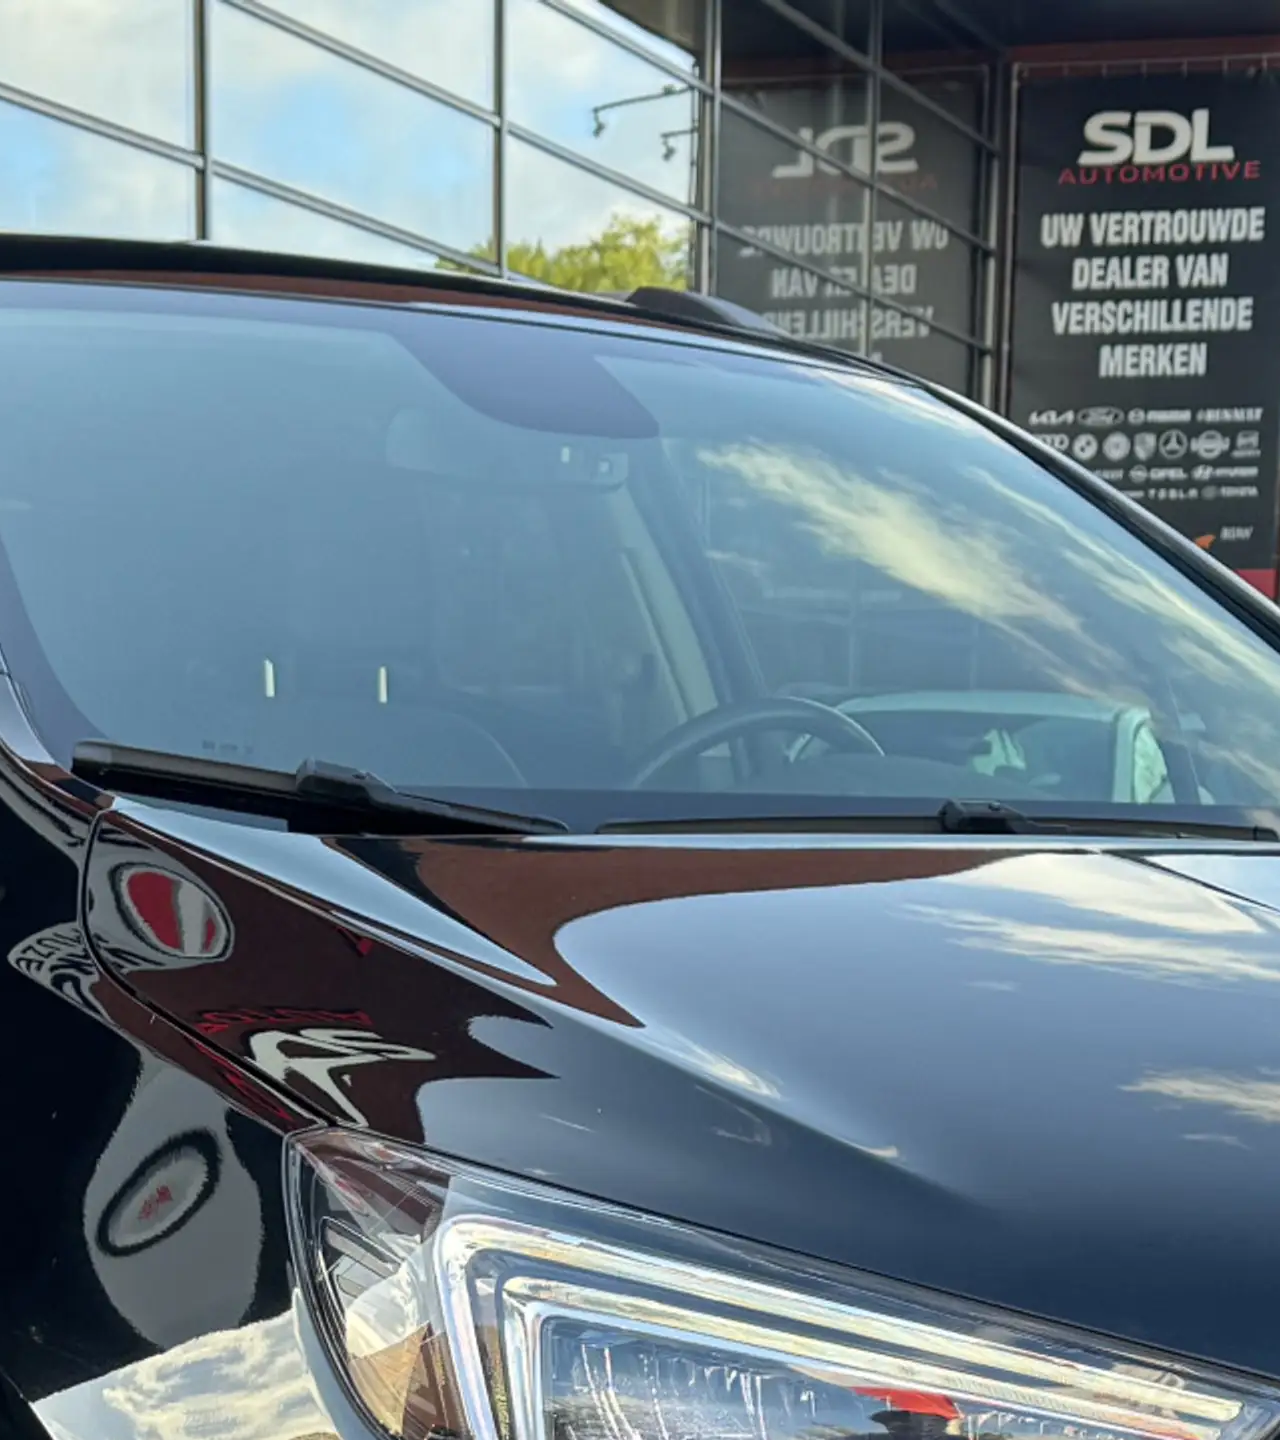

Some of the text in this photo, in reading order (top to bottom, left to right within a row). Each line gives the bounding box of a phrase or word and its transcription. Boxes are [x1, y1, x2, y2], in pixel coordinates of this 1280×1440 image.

[1077, 107, 1235, 166] SDL
[1058, 160, 1261, 185] AUTOMOTIVE
[1040, 207, 1265, 247] UW VERTROUWDE
[1072, 253, 1229, 290] DEALER VAN
[1051, 297, 1254, 335] VERSCHILLENDE
[1098, 343, 1207, 378] MERKEN
